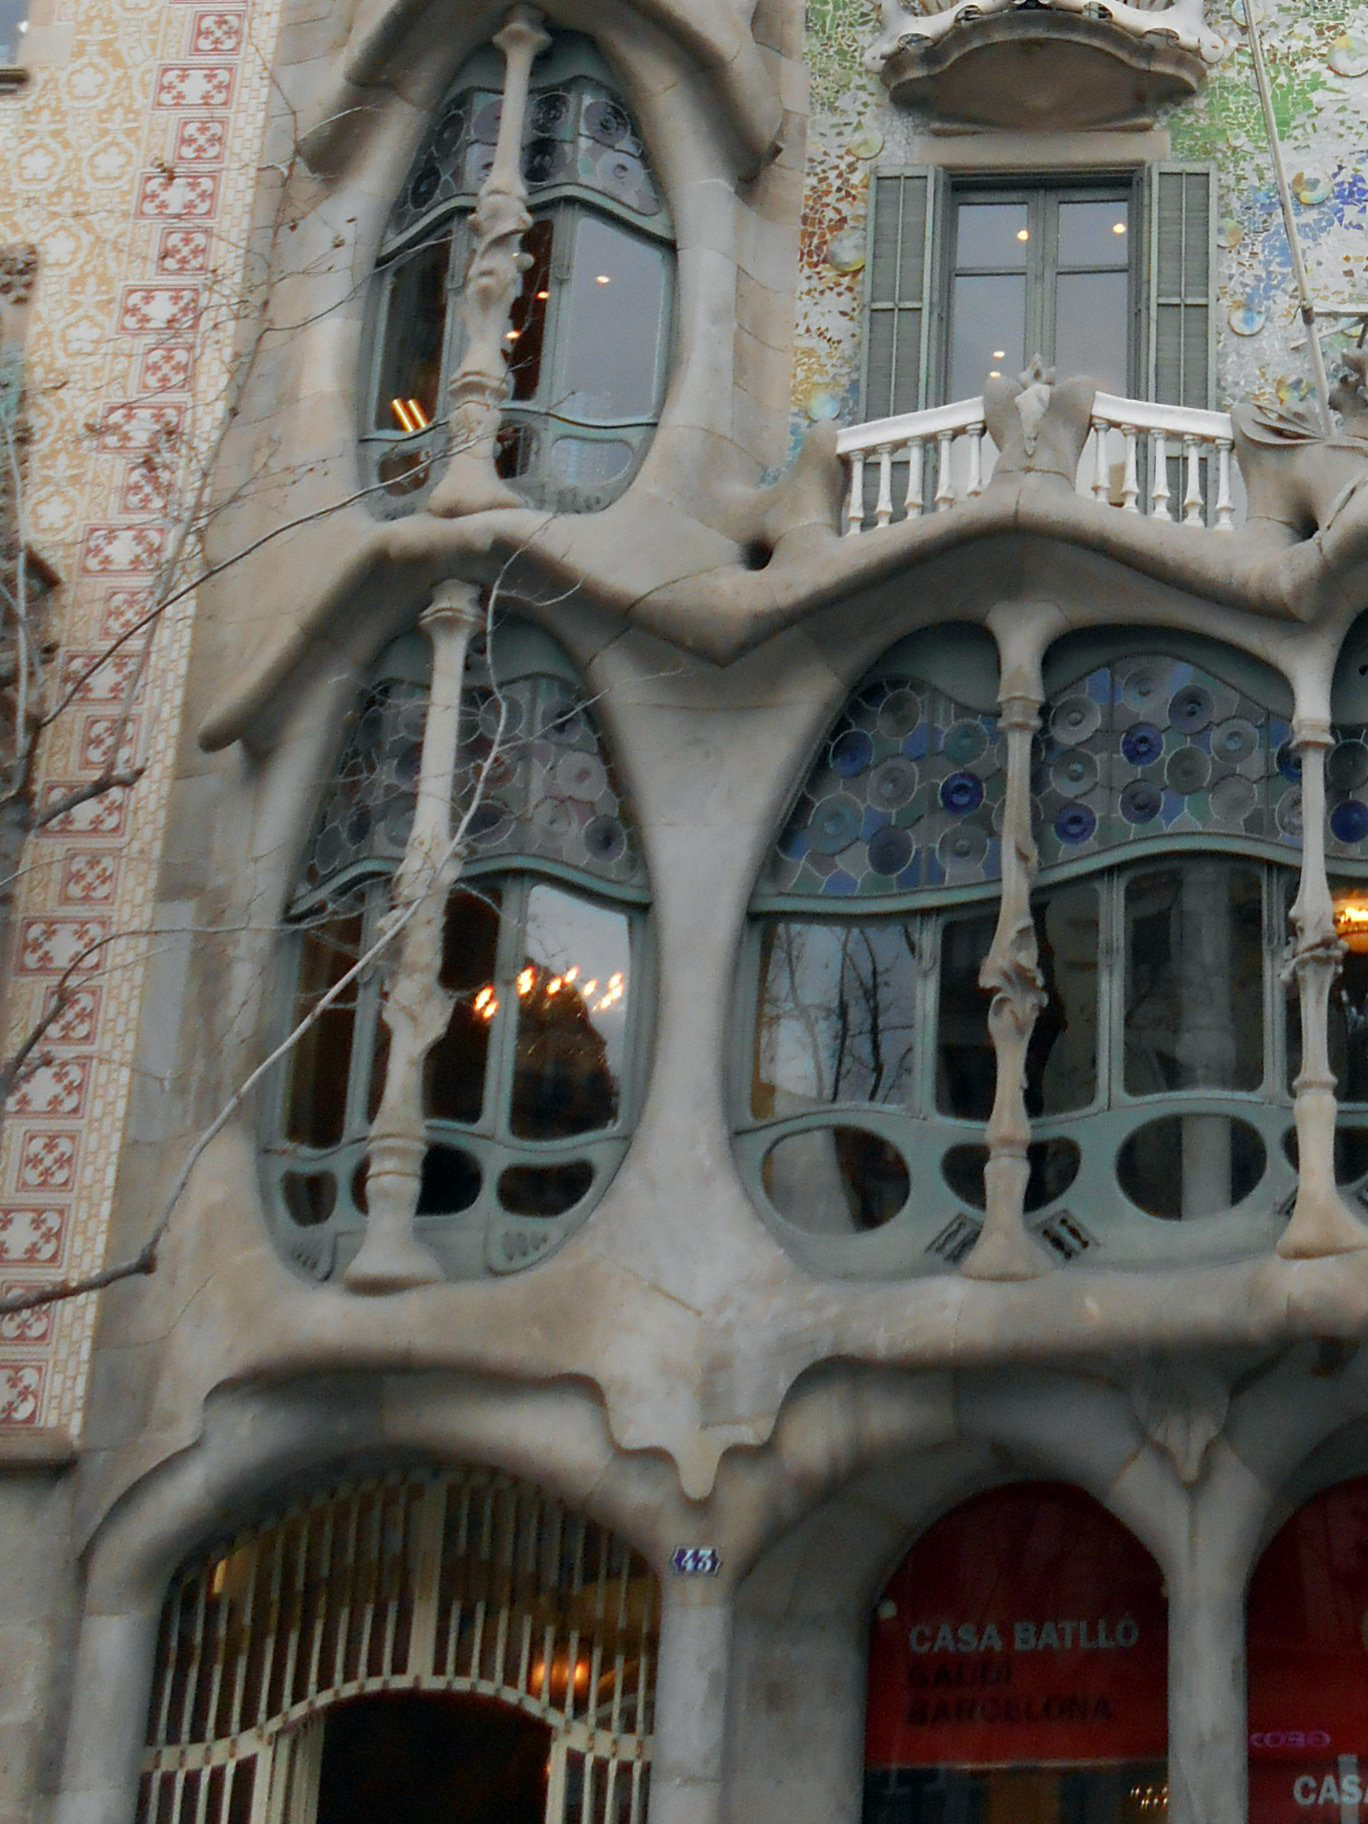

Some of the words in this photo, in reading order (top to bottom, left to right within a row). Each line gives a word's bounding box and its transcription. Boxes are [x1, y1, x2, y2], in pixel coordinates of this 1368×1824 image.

[681, 1550, 712, 1573] 43
[908, 1623, 1002, 1654] CASA
[1013, 1613, 1140, 1652] BATLLÓ
[907, 1695, 1113, 1725] BARCELONA
